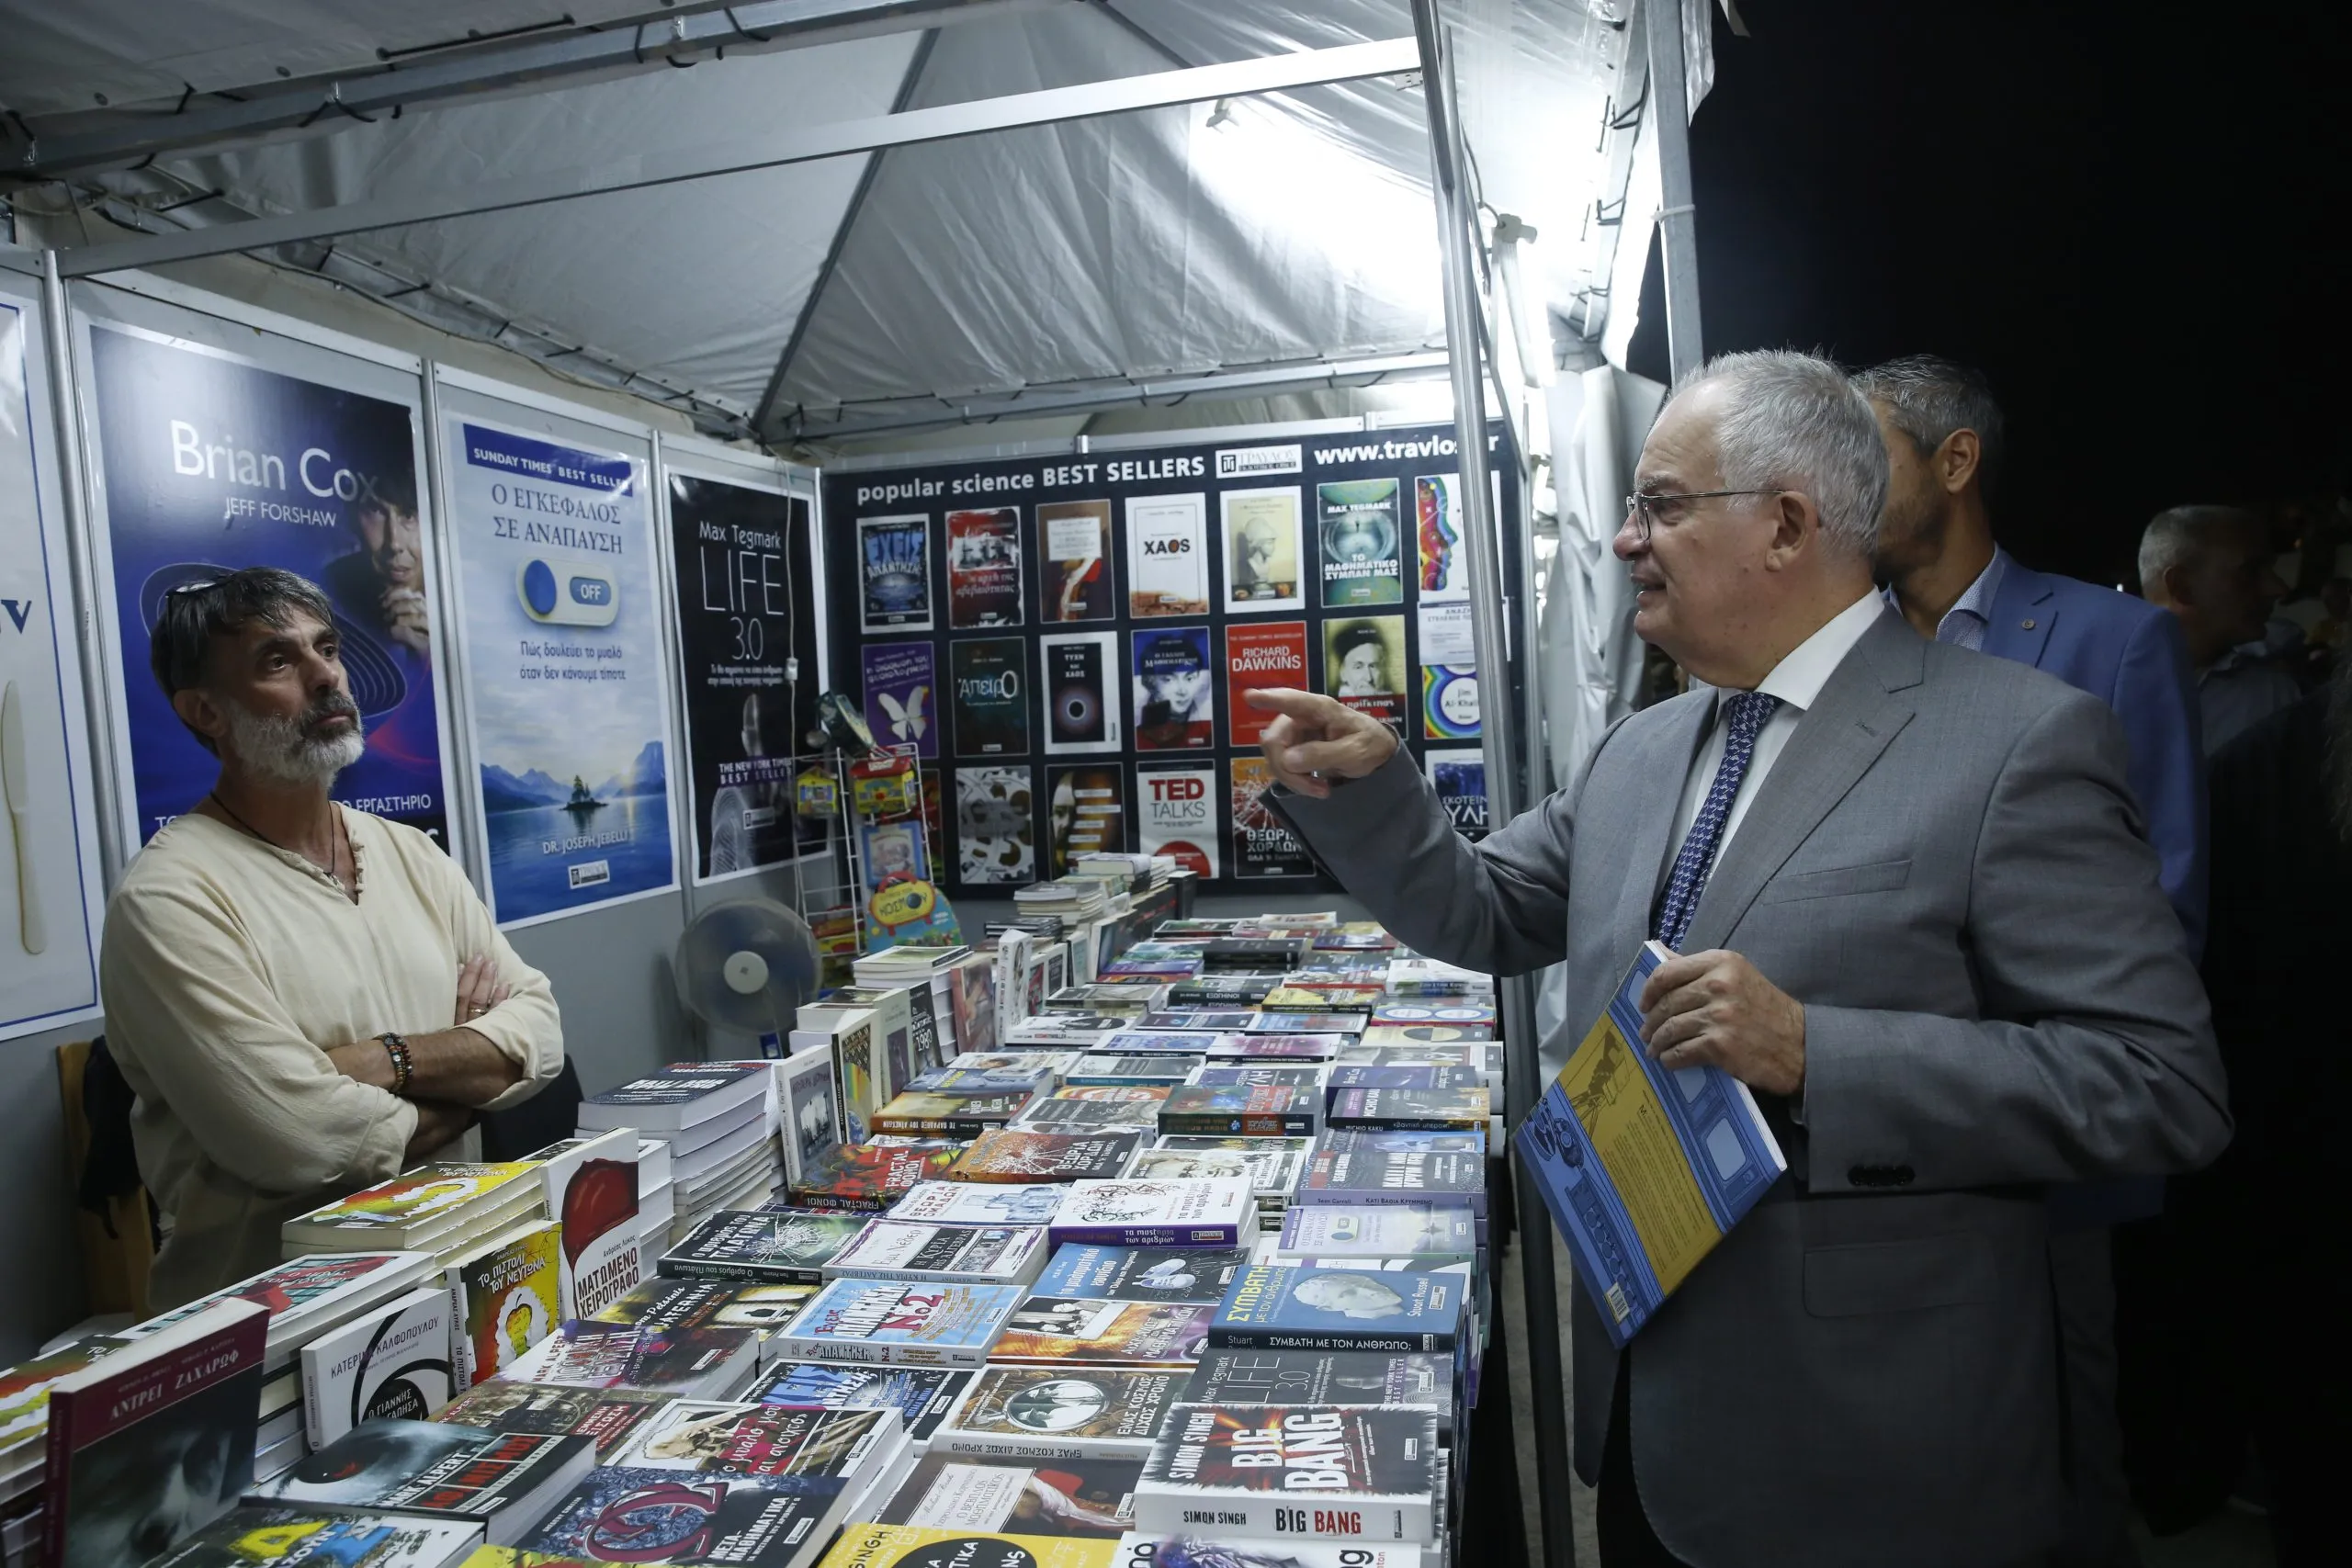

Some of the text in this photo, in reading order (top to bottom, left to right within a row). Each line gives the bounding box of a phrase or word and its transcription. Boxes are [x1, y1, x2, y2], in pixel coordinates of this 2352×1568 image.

[170, 420, 379, 501] Brian Cox
[473, 447, 518, 467] SUNDAY
[521, 457, 552, 474] TIMES
[558, 466, 585, 481] BEST
[857, 456, 1205, 505] popular science BEST SELLERS
[224, 497, 336, 527] JEFF FORSHAW
[492, 483, 621, 525] Ο ΕΓΚΕΦΑΛΟΣ
[493, 516, 623, 554] ΣΕ ΑΝΑΠΑΥΣΗ
[699, 520, 781, 549] Max Tegmark
[581, 583, 602, 600] OFF
[700, 546, 784, 615] LIFE
[520, 641, 542, 659] Πώς
[544, 641, 582, 658] δουλεύει
[585, 647, 594, 659] το
[729, 616, 764, 660] 3.0
[1242, 646, 1290, 659] RICHARD
[520, 665, 597, 682] όταν δεν κάνουμε
[1232, 655, 1302, 672] DAWKINS
[719, 762, 734, 775] THE
[735, 761, 751, 773] NEW
[356, 794, 432, 814] ΕΡΓΑΣΤΗΡΙΟ
[1148, 778, 1204, 801] TED
[1150, 801, 1206, 819] TALKS
[542, 840, 560, 854] DR.
[561, 834, 596, 854] JOSEPH
[1247, 829, 1295, 842] ΘΕΩΡΙ
[885, 1149, 910, 1188] FRACTAL
[1056, 1140, 1088, 1170] ΘΕΩΡΙΑ
[1074, 1140, 1105, 1171] ΧΟΡΔΩΝ
[807, 1197, 879, 1210] FRACTAL ΦΟΝΟΙ
[603, 1235, 637, 1258] Ανδρέας Λύκος
[477, 1253, 526, 1288] ΤΟ ΠΙΣΤΟΛΙ
[577, 1246, 639, 1300] ΜΑΤΩΜΕΝΟ
[674, 1265, 753, 1278] Ο αριθμός του Πλάτωνα
[878, 1271, 895, 1280] ΤΗΣ
[897, 1272, 920, 1280] ΚΥΡΙΑ
[580, 1267, 640, 1321] ΧΕΙΡΟΓΡΑΦΟ
[1226, 1265, 1268, 1323] ΣΥΜΒΑΤΗ
[374, 1316, 439, 1355] ΚΑΛΦΟΠΟΥΛΟΥ
[1227, 1335, 1253, 1346] Stuart
[1270, 1337, 1412, 1351] ΣΥΜΒΑΤΗ ΜΕ ΤΟΝ ΑΝΘΡΩΠΟ;
[174, 1348, 240, 1390] ΖΑΧΑΡΩΦ
[1205, 1356, 1232, 1386] Tegmark
[1388, 1358, 1397, 1372] TIMES
[1218, 1357, 1281, 1404] LIFE
[1275, 1371, 1311, 1391] 3.0
[377, 1388, 412, 1416] ΓΙΑΝΝΗΣ
[757, 1405, 782, 1425] μου
[1117, 1376, 1155, 1436] ΕΝΑΣ ΚΟΣΜΟΣ
[1133, 1375, 1170, 1437] ΔΙΧΩΣ ΧΡΟΝΟ
[952, 1442, 1082, 1459] ΕΝΑΣ ΚΟΣΜΟΣ ΔΙΧΩΣ ΧΡΟΝΟ
[1169, 1411, 1216, 1482] SIMON SINGH
[1231, 1427, 1283, 1469] BIG
[1284, 1412, 1351, 1491] BANG
[424, 1453, 473, 1487] ALPERT
[733, 1496, 790, 1562] ΜΑΘΗΜΑΤΙΚΑ
[1183, 1507, 1362, 1535] SIMON SINGH BIG BANG
[707, 1530, 740, 1559] ΜΕΤΑ-
